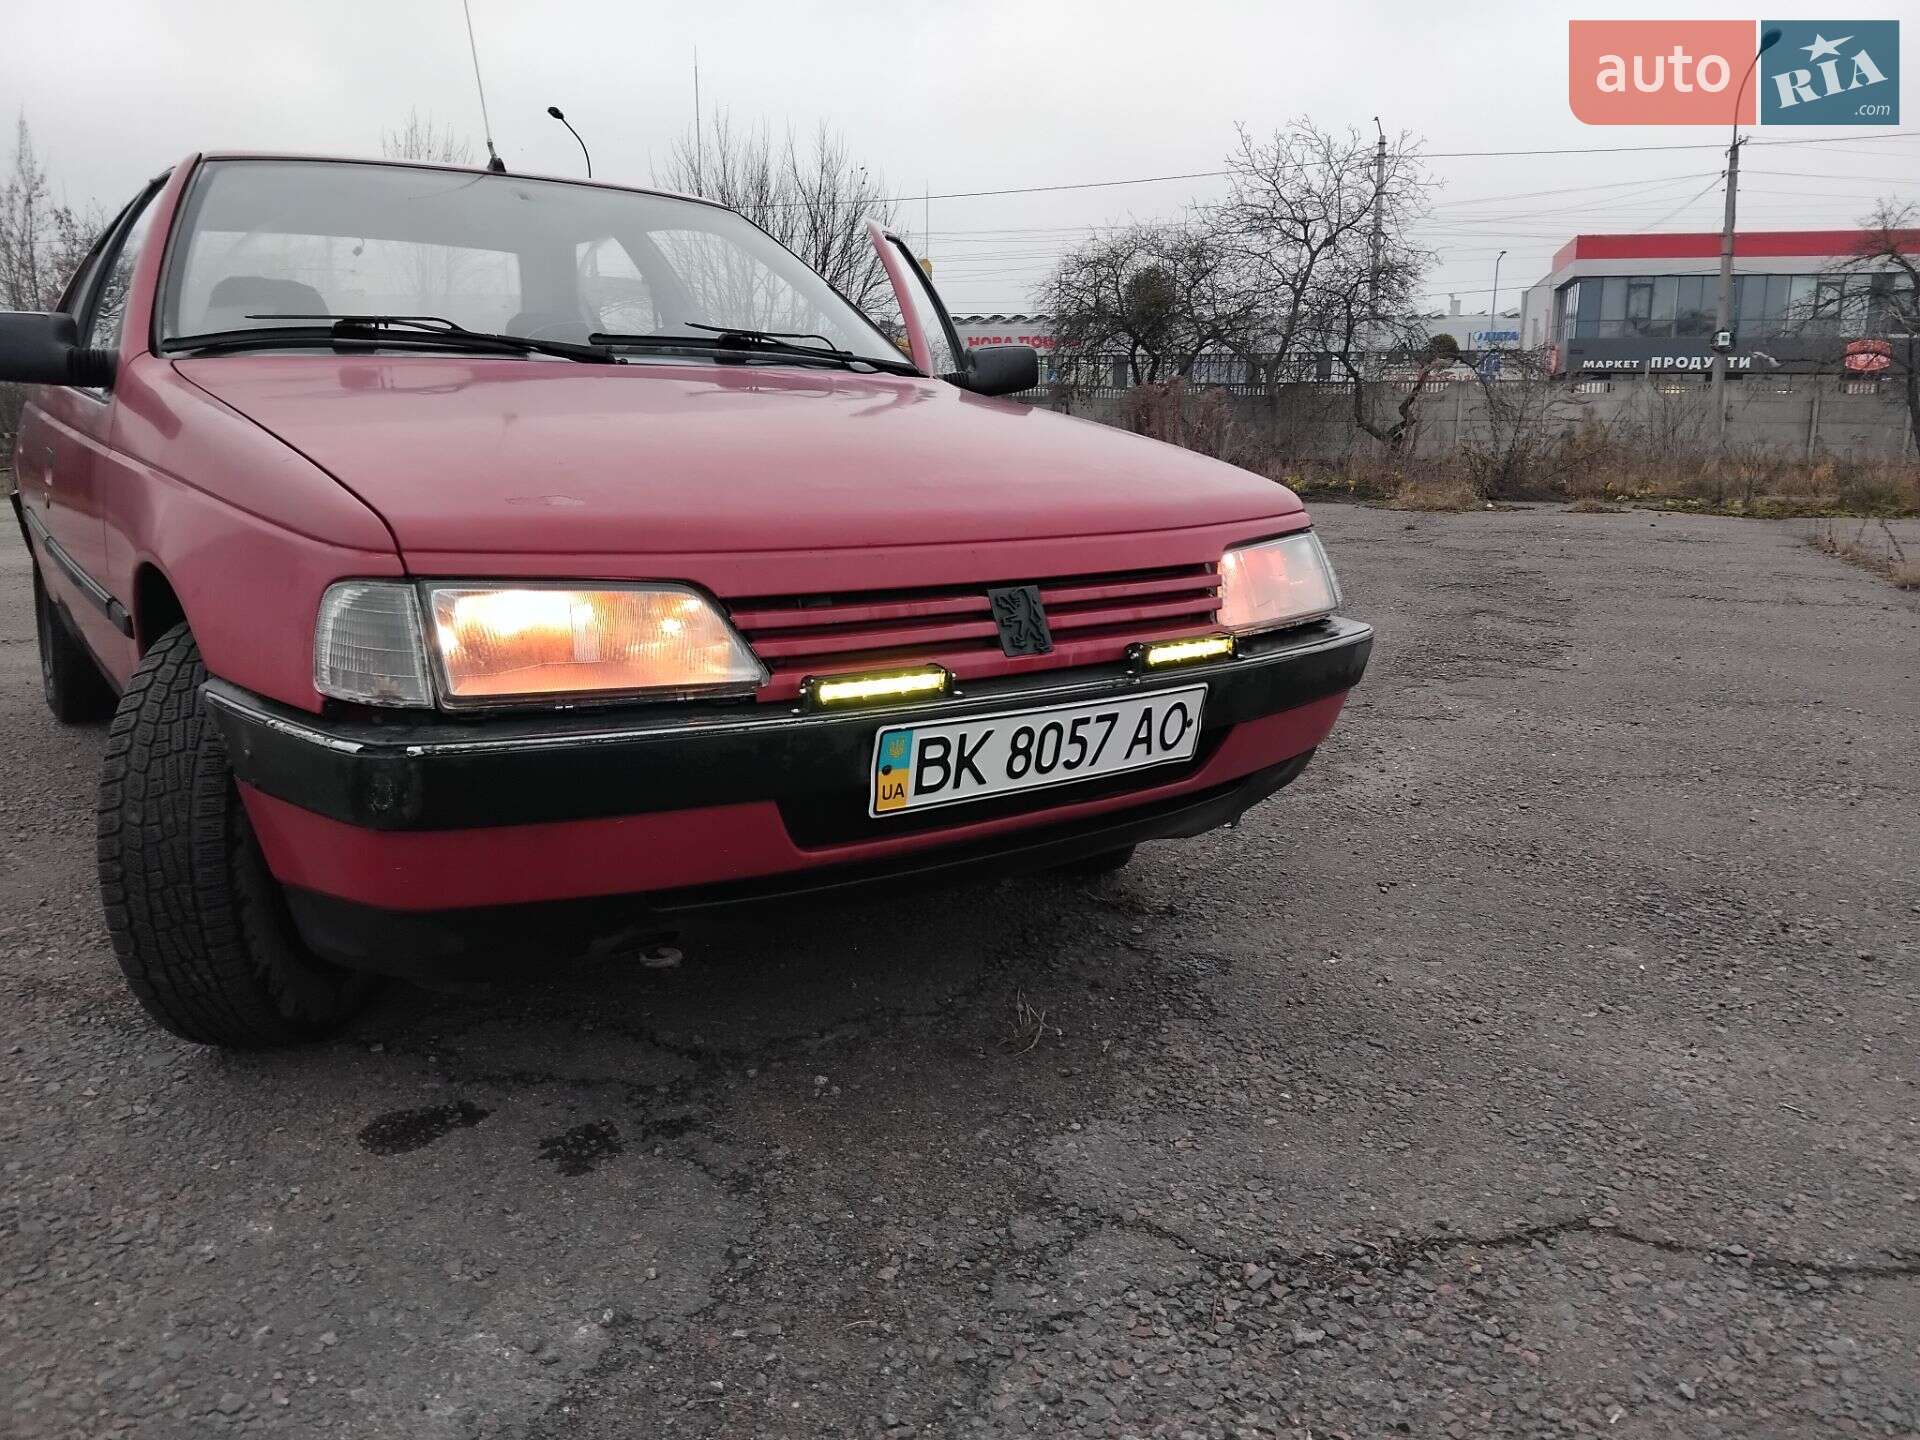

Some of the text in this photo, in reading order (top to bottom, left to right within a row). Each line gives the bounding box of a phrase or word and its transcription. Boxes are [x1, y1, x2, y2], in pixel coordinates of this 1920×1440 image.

[1582, 360, 1639, 369] МАРКЕТ
[1651, 356, 1751, 370] ПРОДУТИ
[914, 700, 1189, 796] BK 8057 AO
[881, 784, 905, 801] UA
